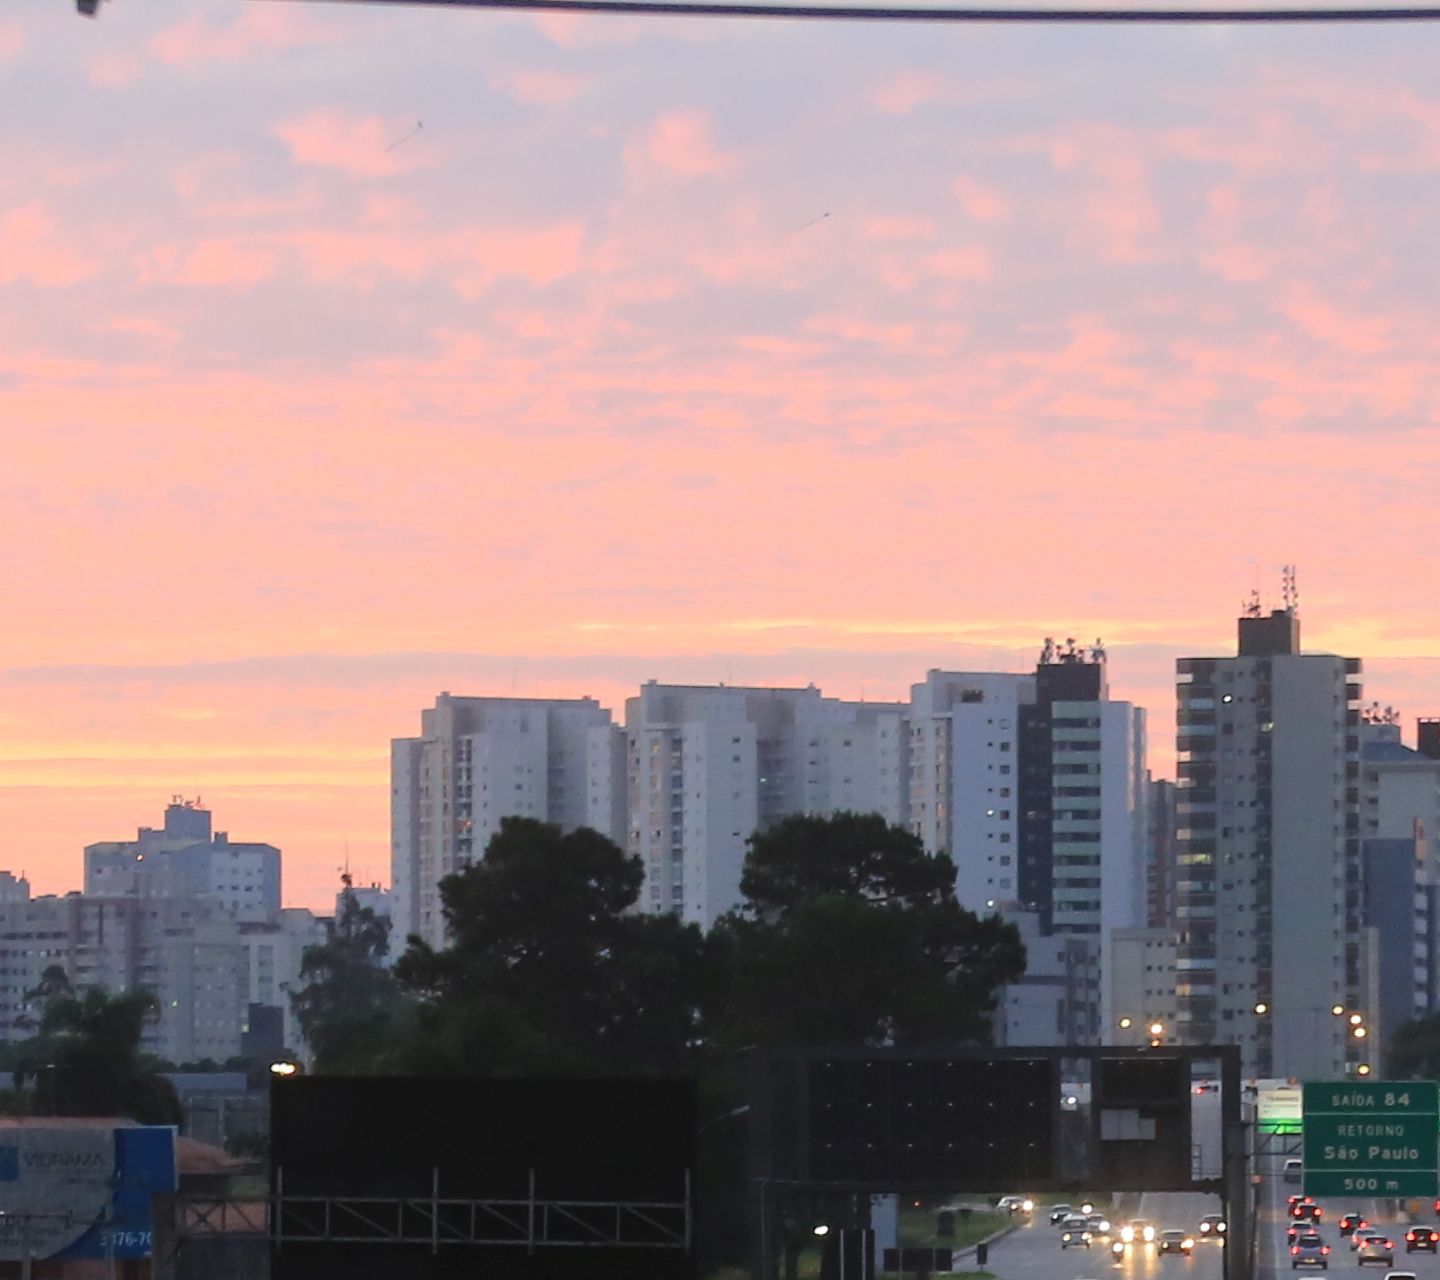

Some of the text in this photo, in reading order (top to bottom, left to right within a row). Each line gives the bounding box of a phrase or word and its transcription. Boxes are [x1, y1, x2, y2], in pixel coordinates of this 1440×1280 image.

[1332, 1093, 1410, 1106] SAÍDA 84
[1337, 1125, 1404, 1137] RETORNO
[1324, 1146, 1419, 1160] São Paulo
[1344, 1179, 1378, 1190] 500
